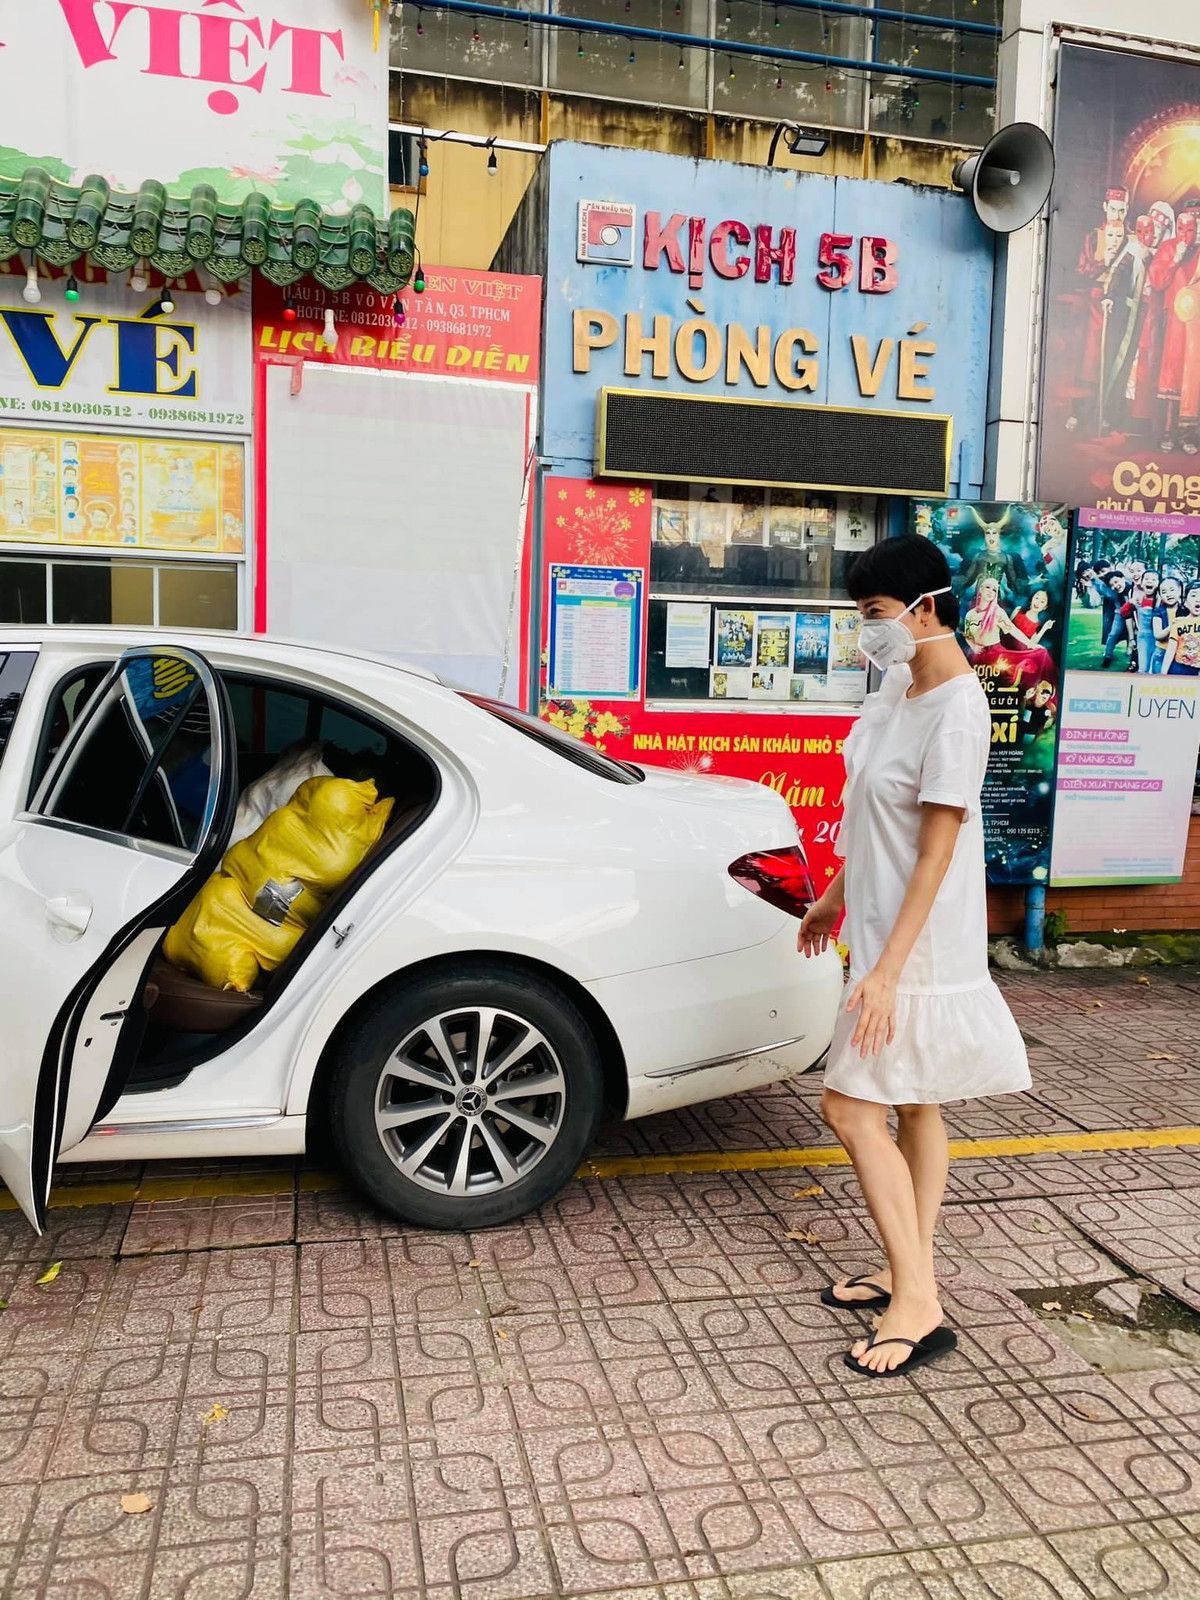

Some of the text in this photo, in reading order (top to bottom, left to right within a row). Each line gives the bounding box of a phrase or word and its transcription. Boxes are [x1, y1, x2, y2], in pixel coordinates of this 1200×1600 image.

[58, 0, 345, 115] VIỆT
[643, 211, 899, 294] KỊCH 5B
[461, 279, 523, 302] VIỆT
[470, 306, 511, 321] TPHCM
[296, 305, 348, 322] HOTLNE:
[351, 311, 417, 330] 081203012
[426, 319, 492, 338] 0938681972
[0, 298, 199, 400] VÉ
[259, 326, 530, 374] LỊCH BIỂU DIỄN
[572, 297, 938, 401] PHÒNG VÉ
[31, 399, 132, 418] 0812030512
[149, 410, 245, 425] 0938681972
[1112, 460, 1200, 508] Công
[633, 732, 663, 750] NHÀ
[666, 734, 696, 751] HÁT
[698, 736, 730, 754] KỊCH
[733, 735, 760, 753] SÂN
[762, 733, 801, 753] KHẤU
[803, 735, 832, 753] NHỎ
